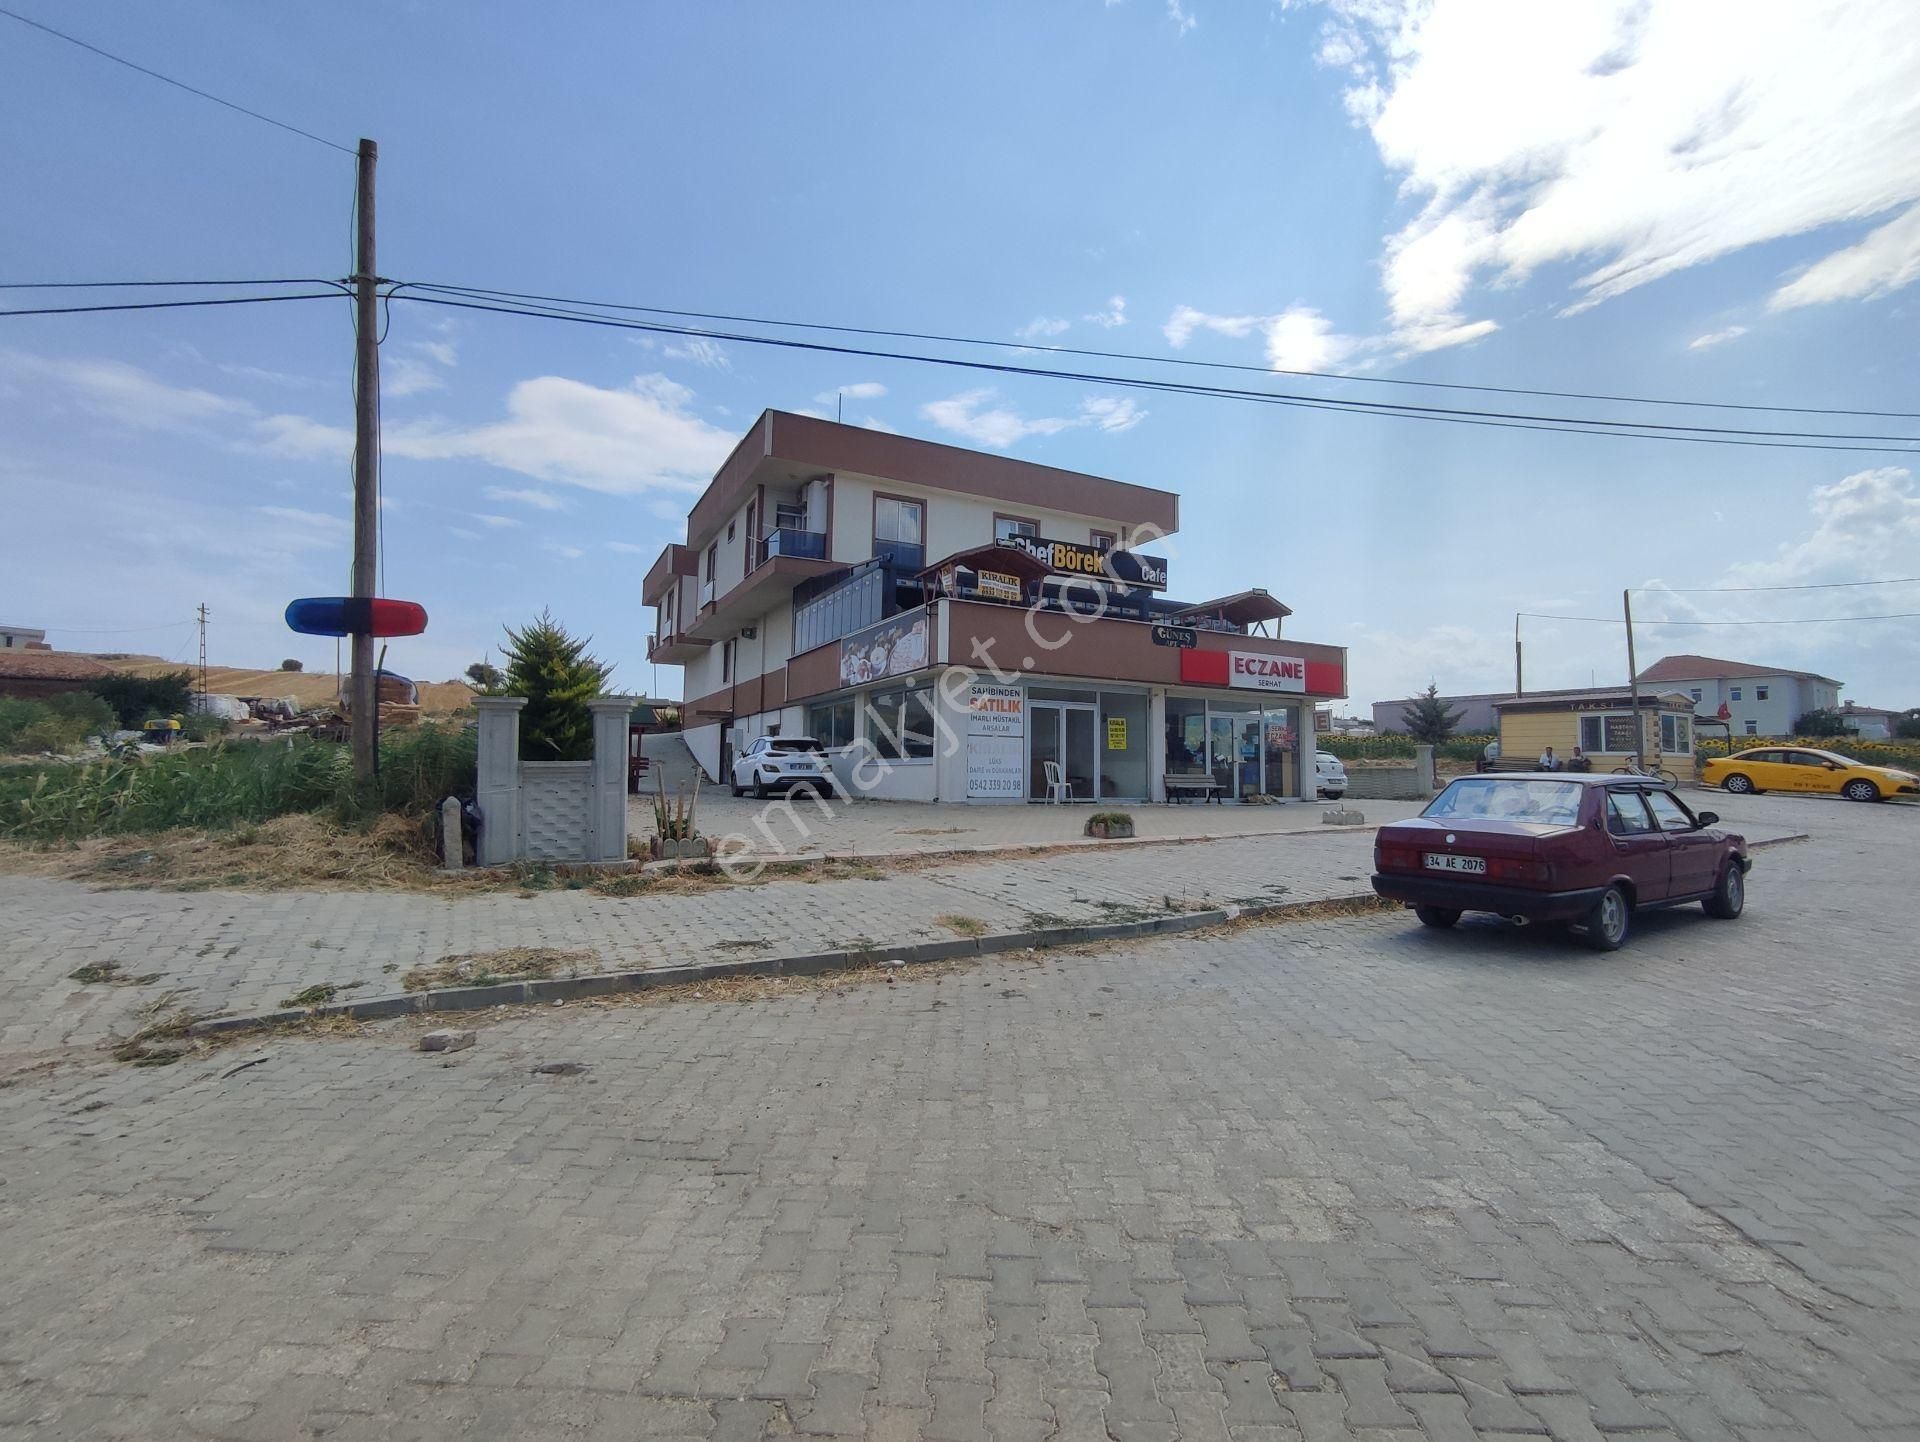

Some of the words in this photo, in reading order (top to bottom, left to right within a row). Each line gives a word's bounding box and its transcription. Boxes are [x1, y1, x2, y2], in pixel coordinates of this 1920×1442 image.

[1141, 565, 1167, 584] Cafe
[1234, 656, 1304, 679] ECZANE
[1258, 679, 1281, 688] SERHAT
[970, 697, 1022, 713] SATILIK
[969, 779, 987, 790] 0542
[989, 779, 1001, 790] 339
[1002, 779, 1011, 790] 20
[1013, 779, 1021, 790] 98
[1429, 856, 1440, 866] 34
[1446, 857, 1457, 869] AE
[1461, 859, 1485, 871] 2076
